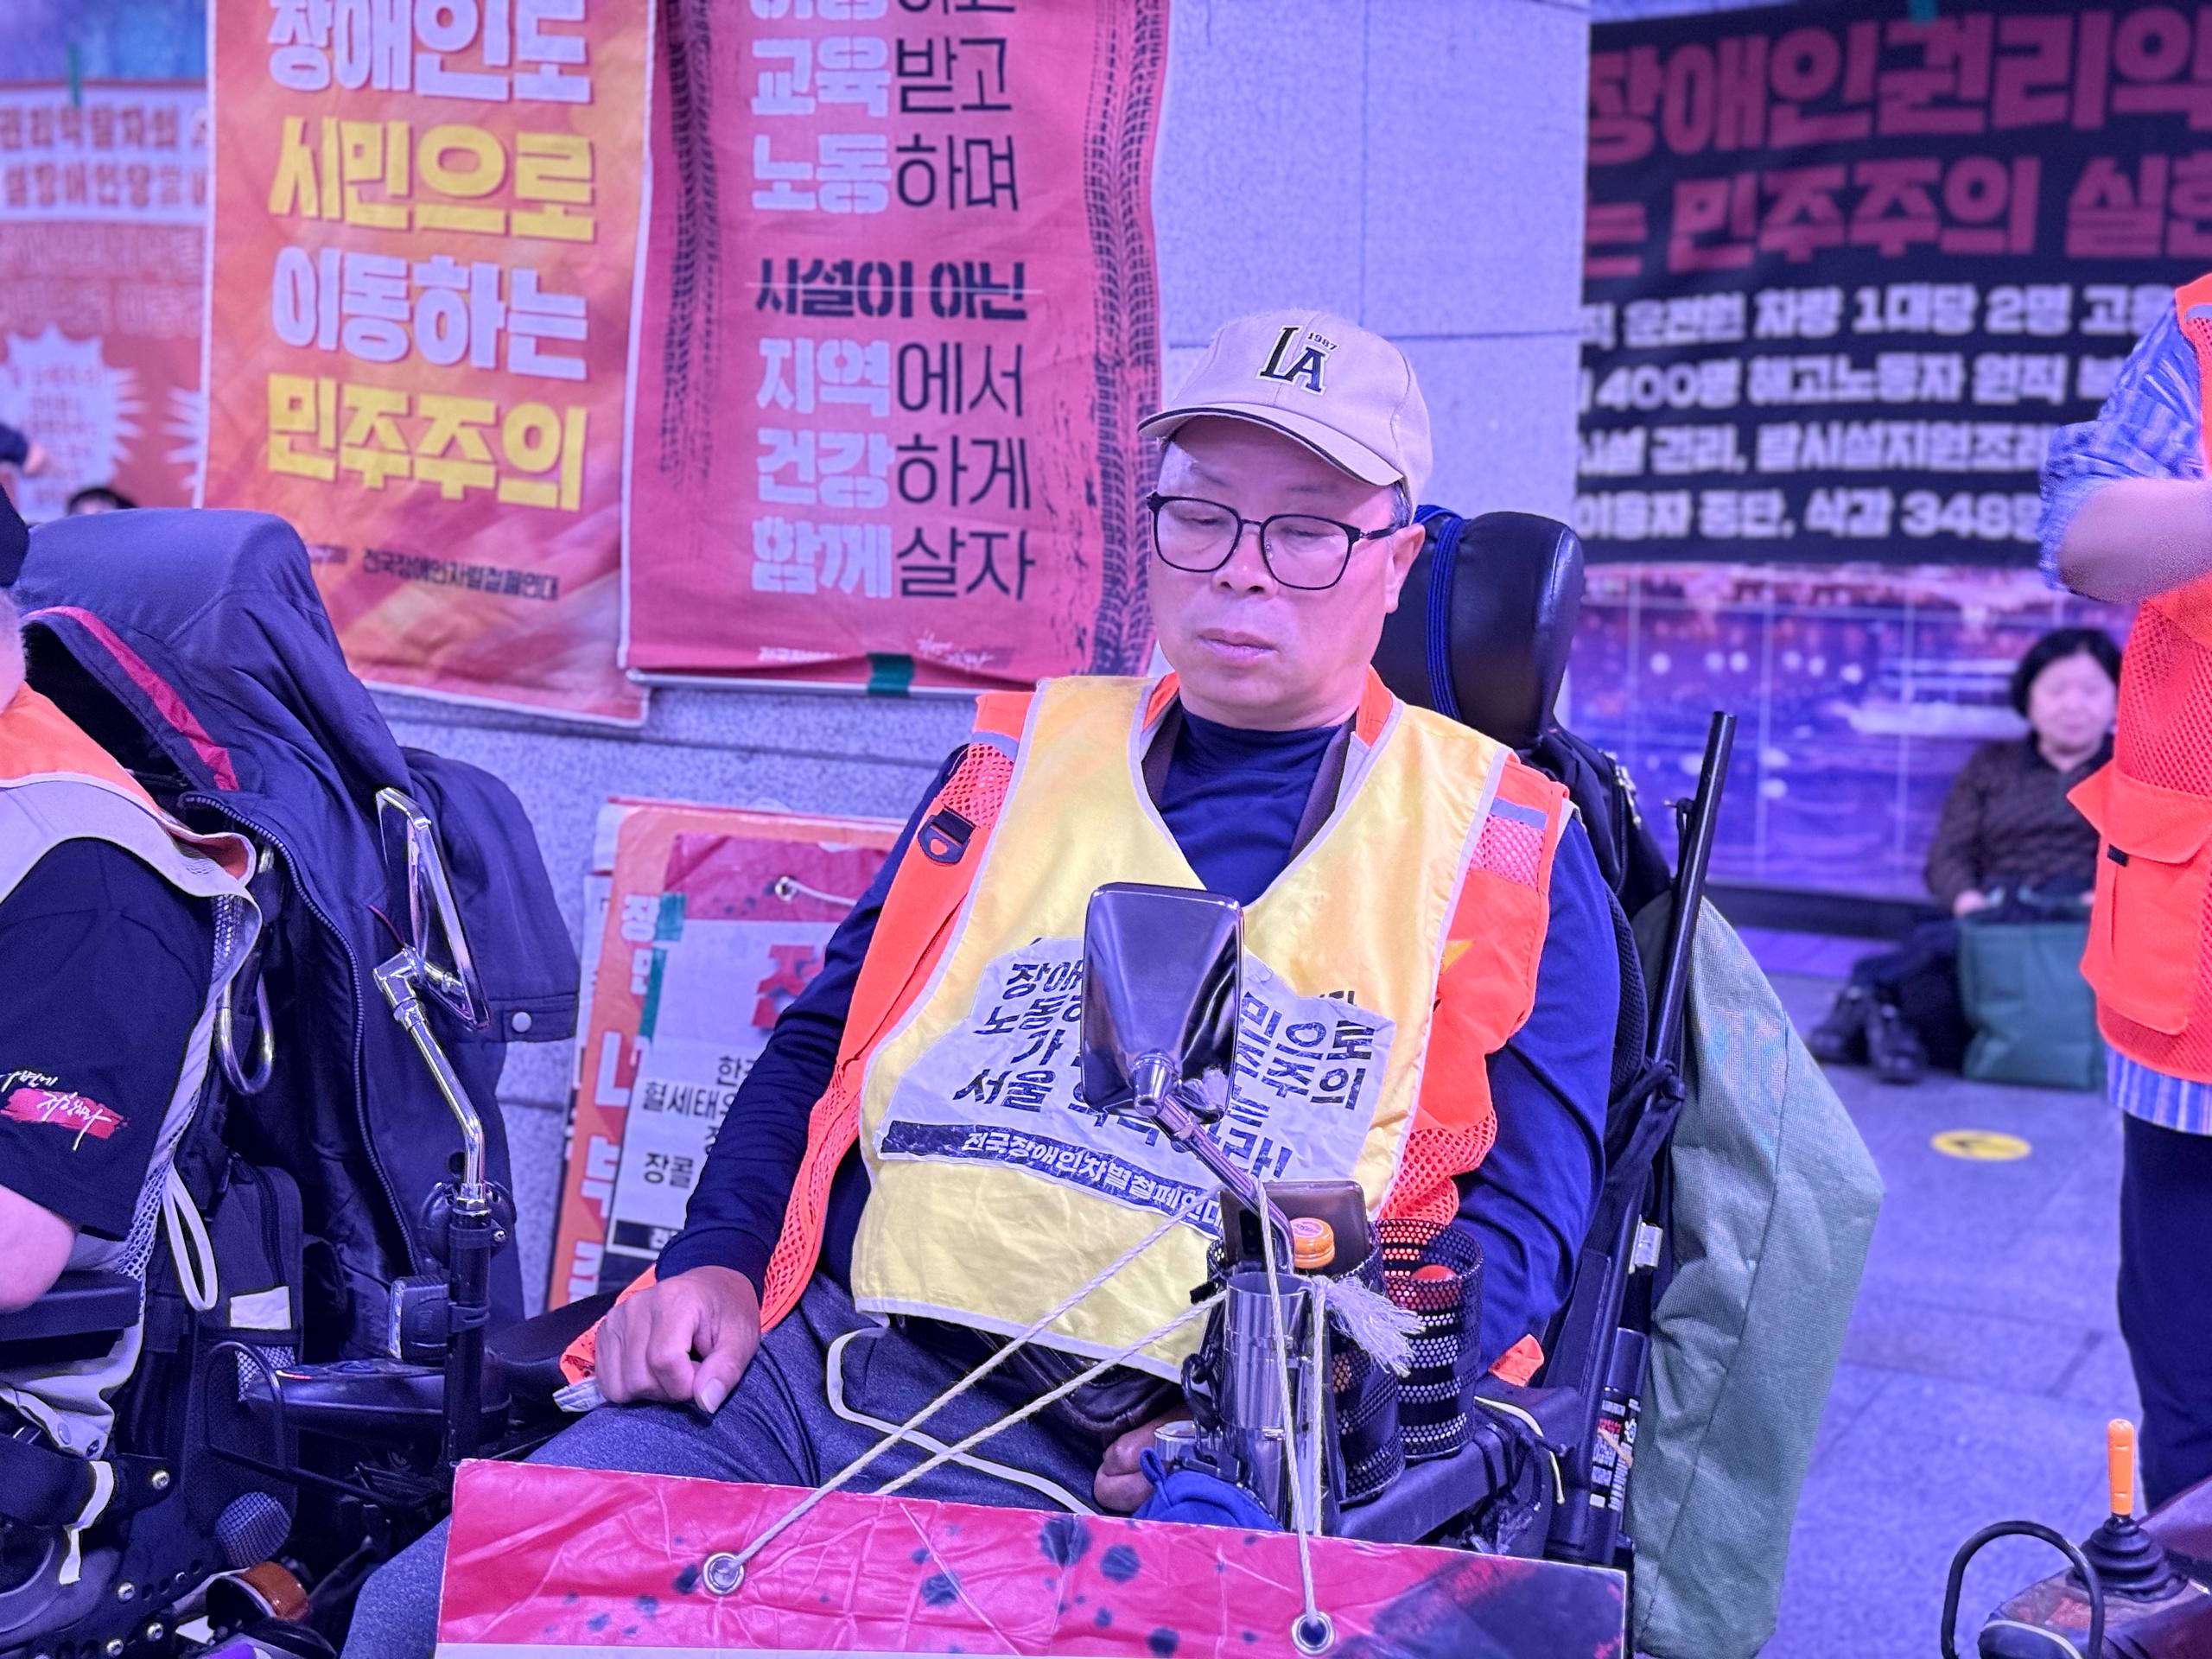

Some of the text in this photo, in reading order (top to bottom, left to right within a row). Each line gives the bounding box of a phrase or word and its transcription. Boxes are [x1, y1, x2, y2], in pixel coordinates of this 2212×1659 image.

[268, 0, 592, 103] 장애인도
[751, 36, 1012, 118] 교육받고
[268, 116, 595, 242] 시민으로
[751, 133, 1019, 213] 노동하며
[1666, 156, 2041, 275] 민주주의
[270, 246, 588, 380] 이동하는
[755, 258, 1027, 321] 시설이 아닌
[756, 337, 1023, 418] 지역에서
[1258, 326, 1327, 394] LA
[268, 372, 588, 512] 민주주의
[756, 428, 1031, 510] 건강하게
[952, 1069, 1057, 1113] 서울
